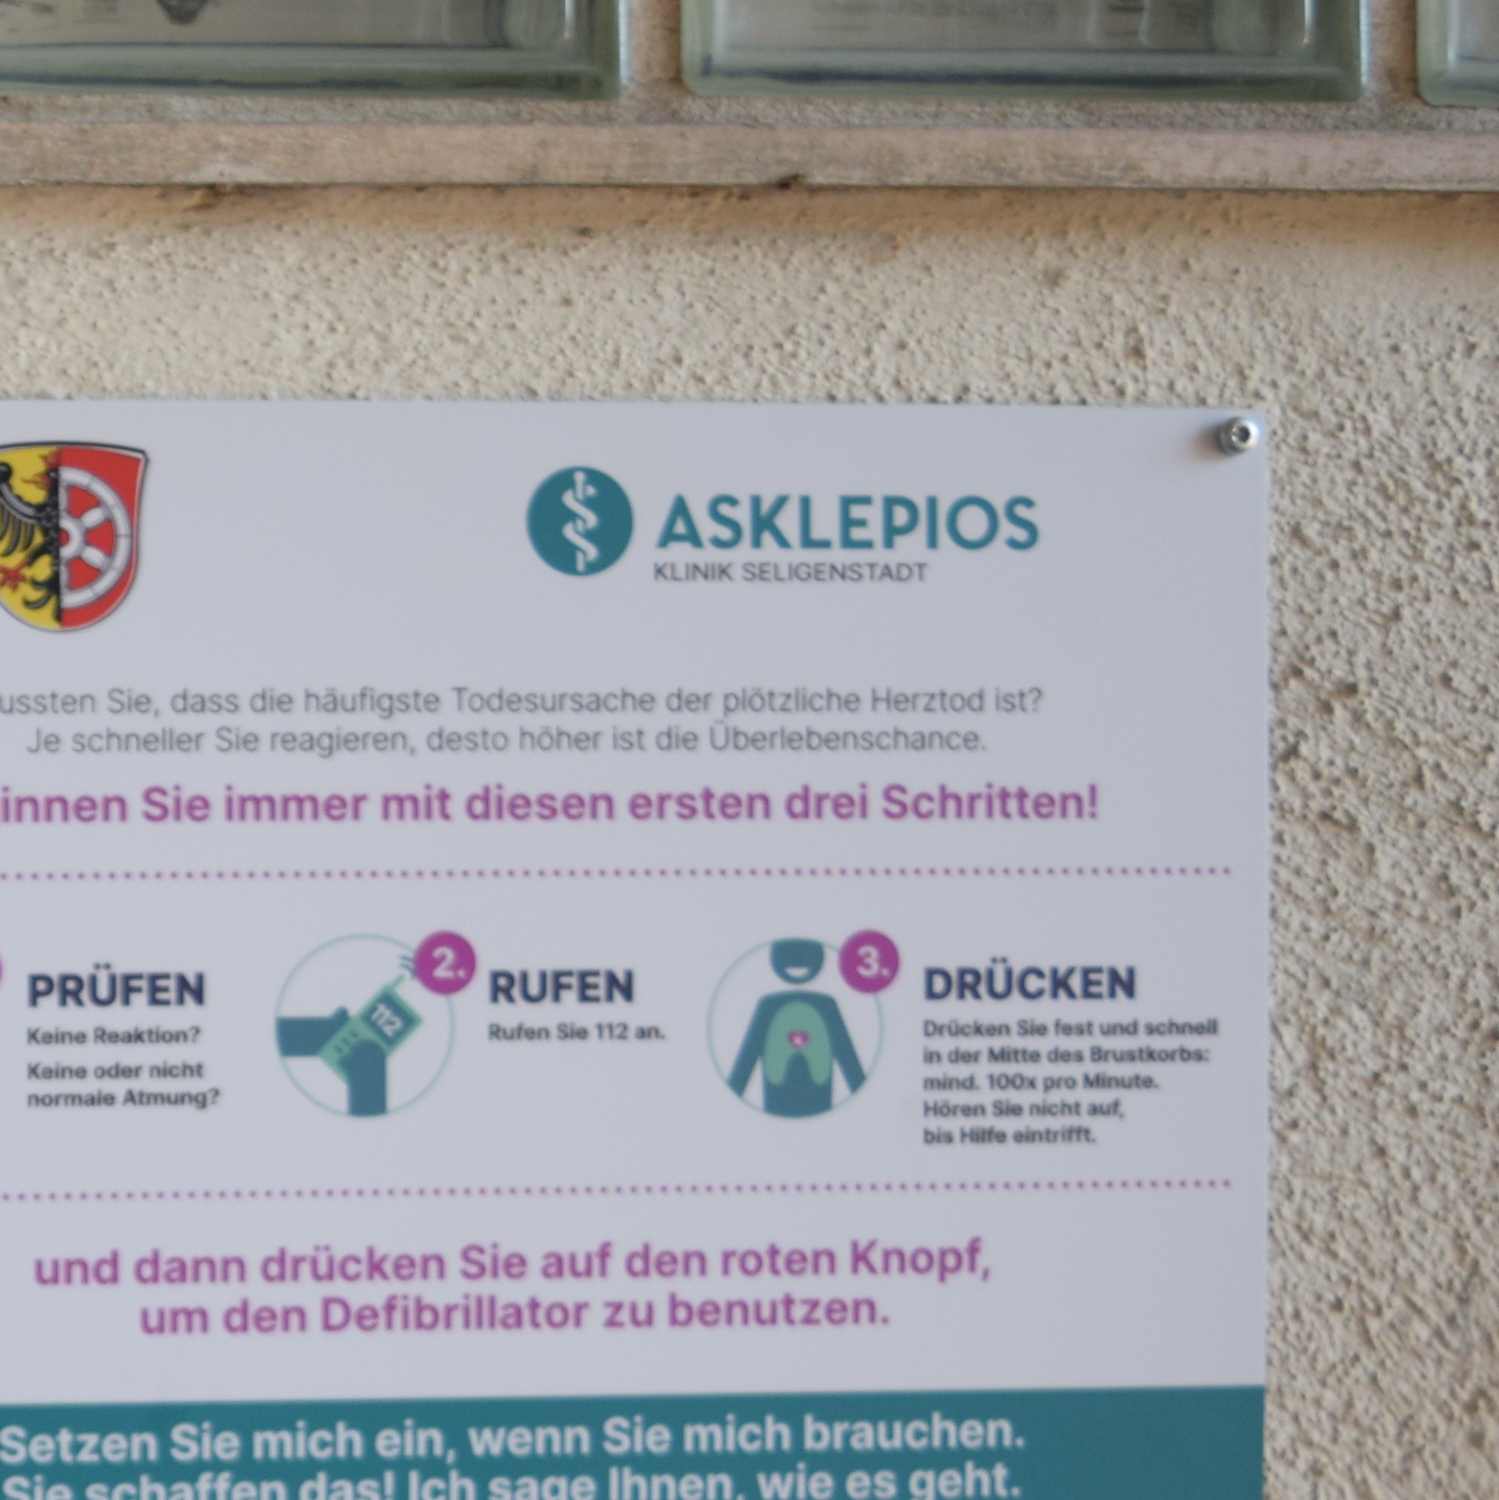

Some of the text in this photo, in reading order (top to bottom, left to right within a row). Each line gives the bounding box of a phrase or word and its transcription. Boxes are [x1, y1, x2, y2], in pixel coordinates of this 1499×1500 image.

[656, 493, 1040, 552] ASKLEPIOS
[653, 561, 928, 584] KLINIK SELIGENSTADT
[107, 686, 160, 718] Sie,
[169, 688, 241, 715] dass
[248, 688, 295, 715] die
[303, 685, 442, 721] häufigste
[450, 686, 658, 715] Todesursache
[664, 687, 714, 715] der
[722, 686, 863, 719] plötzliche
[870, 686, 987, 715] Herztod
[994, 685, 1045, 715] ist?
[26, 720, 987, 759] Je schneller Sie reagieren, desto höher ist die Überlebenschance.
[141, 784, 212, 824] Sie
[224, 784, 369, 823] immer
[380, 783, 452, 822] mit
[464, 783, 616, 822] diesen
[627, 786, 773, 822] ersten
[783, 781, 870, 821] drei
[881, 780, 1099, 822] Schritten!
[431, 946, 466, 979] 2.
[856, 945, 890, 979] 3.
[924, 956, 1137, 1002] DRÜCKEN
[27, 962, 206, 1008] PRÜFEN
[489, 968, 635, 1005] RUFEN
[26, 1025, 202, 1046] Keine Reaktion?
[370, 1003, 403, 1038] 112
[487, 1021, 666, 1042] Rufen Sie 112 an.
[923, 1017, 1220, 1039] Drücken Sie fest und schnell
[26, 1060, 204, 1081] Keine oder nicht
[922, 1044, 1210, 1065] in der Mitte des Brustkorbs:
[27, 1087, 221, 1111] normale Atmung?
[922, 1071, 1160, 1095] mind. 100x pro Minute.
[922, 1098, 1124, 1120] Hören Sie nicht auf,
[922, 1124, 1096, 1146] bis Hilfe eintrifft.
[34, 1235, 991, 1287] und dann drücken Sie auf den roten Knopf,
[140, 1291, 890, 1336] um den Defibrillator zu benutzen.
[169, 1420, 242, 1464] Sie
[252, 1419, 365, 1461] mich
[374, 1417, 457, 1464] ein,
[467, 1424, 592, 1458] wenn
[602, 1414, 673, 1457] Sie
[683, 1412, 792, 1455] mich
[803, 1411, 1025, 1452] brauchen.
